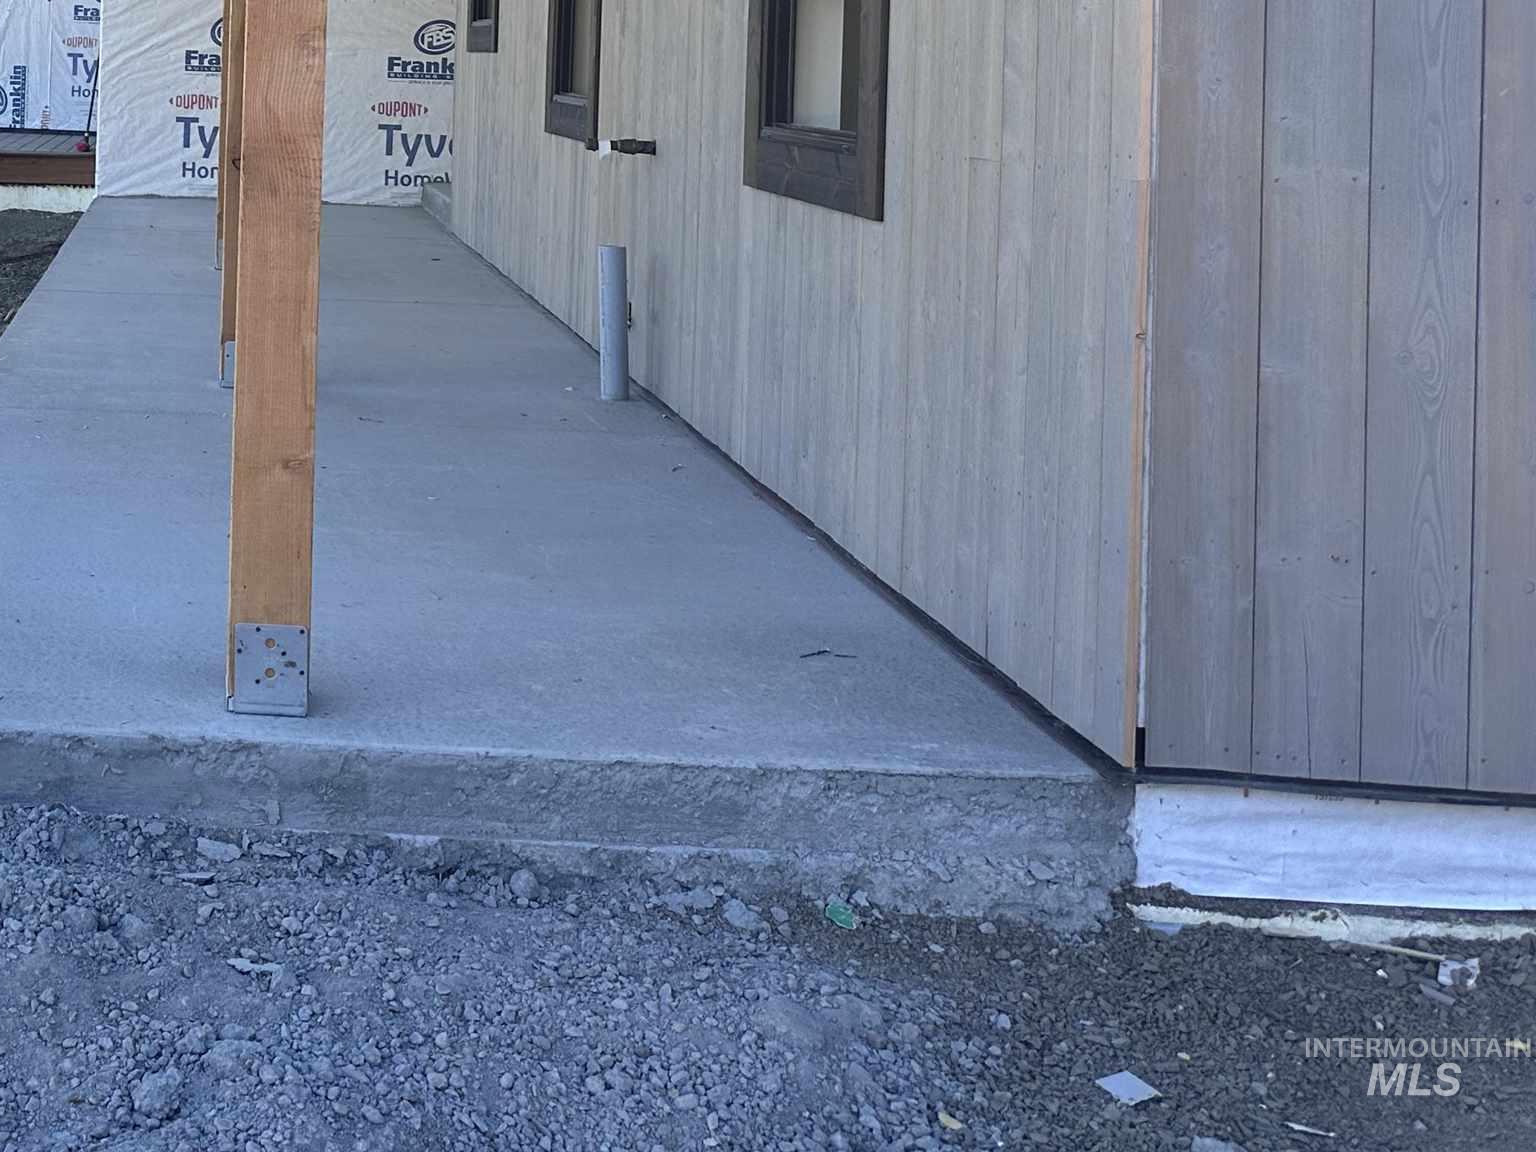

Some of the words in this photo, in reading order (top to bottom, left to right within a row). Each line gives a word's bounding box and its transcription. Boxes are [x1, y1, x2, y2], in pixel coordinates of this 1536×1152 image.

[176, 94, 219, 110] DUPONT
[378, 101, 422, 117] DUPONT
[378, 124, 453, 167] Tyv
